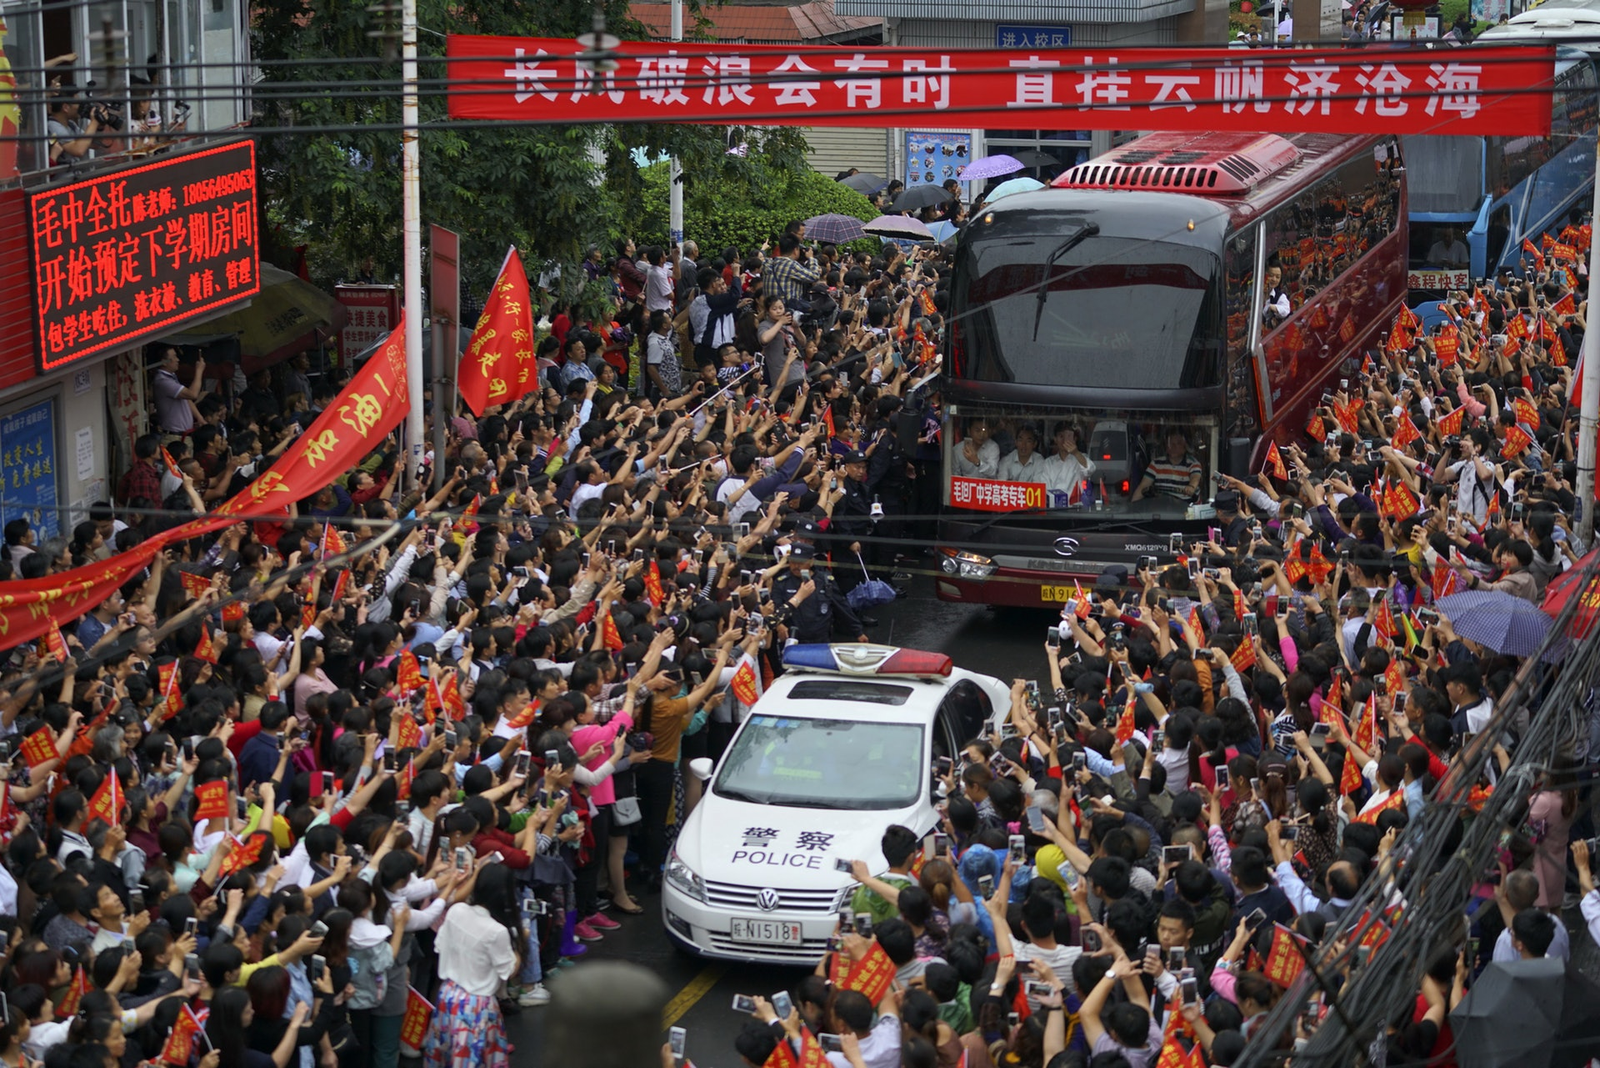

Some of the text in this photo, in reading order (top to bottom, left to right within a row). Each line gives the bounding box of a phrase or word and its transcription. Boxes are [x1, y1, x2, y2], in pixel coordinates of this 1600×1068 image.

[1002, 32, 1065, 48] 进入校区
[505, 47, 1483, 119] 长风破浪会有时 直挂云帆济沧海
[41, 200, 252, 315] 开始预定下学期房间
[1408, 273, 1467, 290] 鑫程快客
[741, 827, 834, 851] 警察
[731, 850, 823, 869] POLICE
